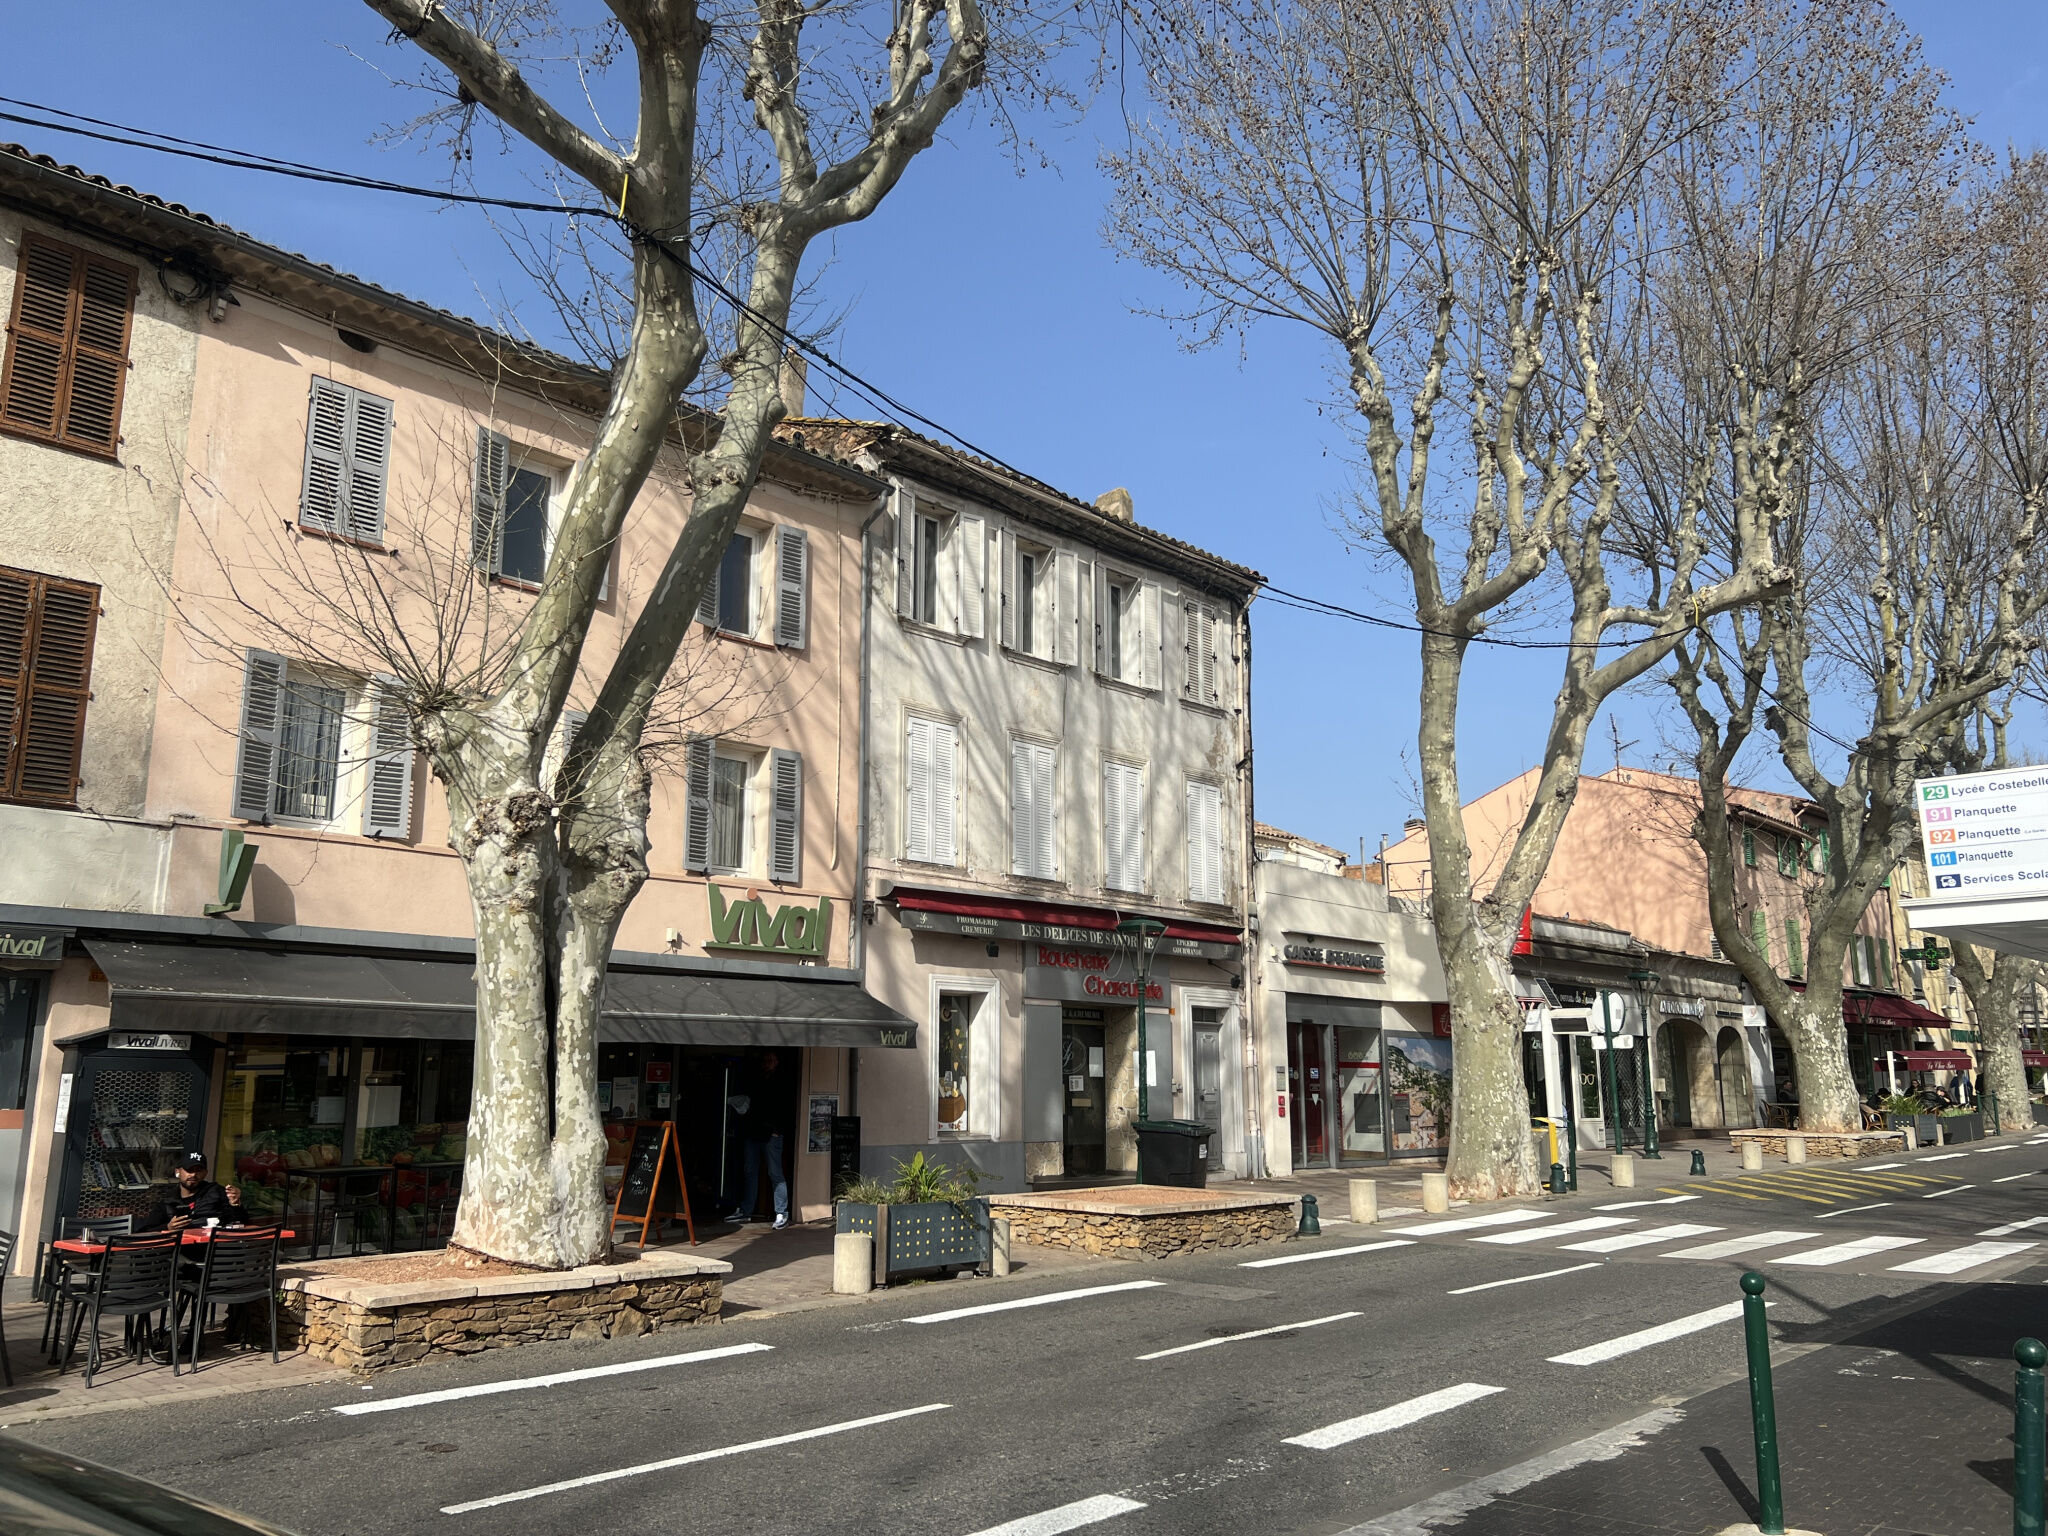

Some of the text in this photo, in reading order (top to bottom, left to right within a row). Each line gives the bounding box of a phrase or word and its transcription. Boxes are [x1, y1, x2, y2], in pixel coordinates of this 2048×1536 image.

[1927, 786, 1946, 800] 29
[1951, 784, 1985, 796] Lycée
[1930, 804, 2017, 821] 91 Planquette
[1932, 826, 2021, 843] 92 Planquette
[1934, 849, 2014, 865] 101 Planquette
[1963, 873, 2014, 885] Services
[956, 916, 999, 926] FROMAGERIE
[961, 925, 995, 935] CREMERIE
[1020, 923, 1155, 950] LES DELICES DE SANDRNE
[1037, 945, 1110, 971] Boucherie
[1283, 944, 1324, 962] CAISSE
[190, 1152, 202, 1161] NY
